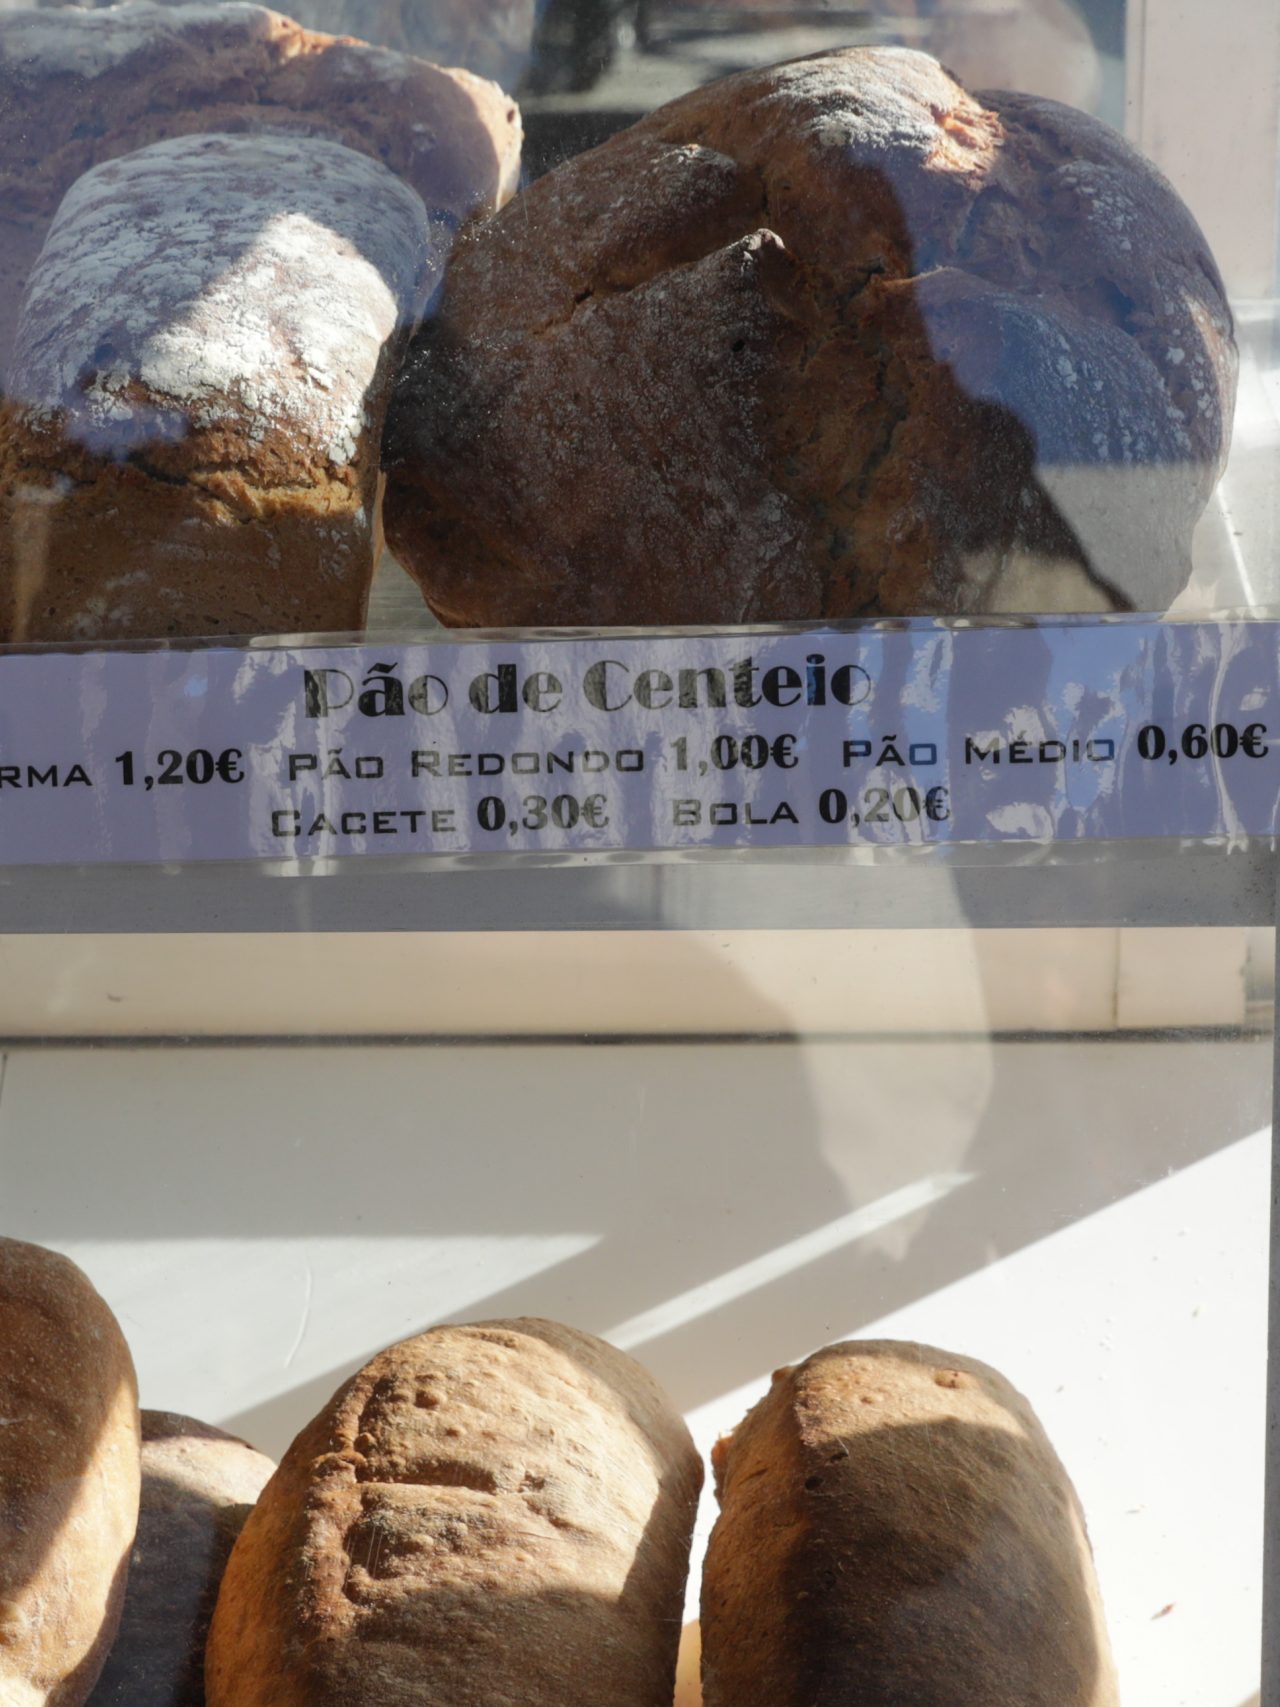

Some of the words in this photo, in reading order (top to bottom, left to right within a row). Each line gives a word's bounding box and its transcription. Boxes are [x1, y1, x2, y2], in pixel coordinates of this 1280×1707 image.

[303, 661, 450, 719] Pão
[468, 663, 564, 715] de
[582, 653, 872, 712] Centeio
[115, 748, 246, 791] 1,20€
[288, 748, 384, 782] PÃO
[411, 749, 645, 778] REDONDO
[669, 733, 799, 777] 1,00€
[842, 734, 938, 768] PÃO
[964, 730, 1115, 765] MÉDIO
[1137, 722, 1270, 765] 0,60€
[271, 809, 457, 838] CACETE
[476, 793, 610, 838] 0,30€
[672, 798, 799, 827] BOLA
[818, 785, 951, 828] 0,20€
